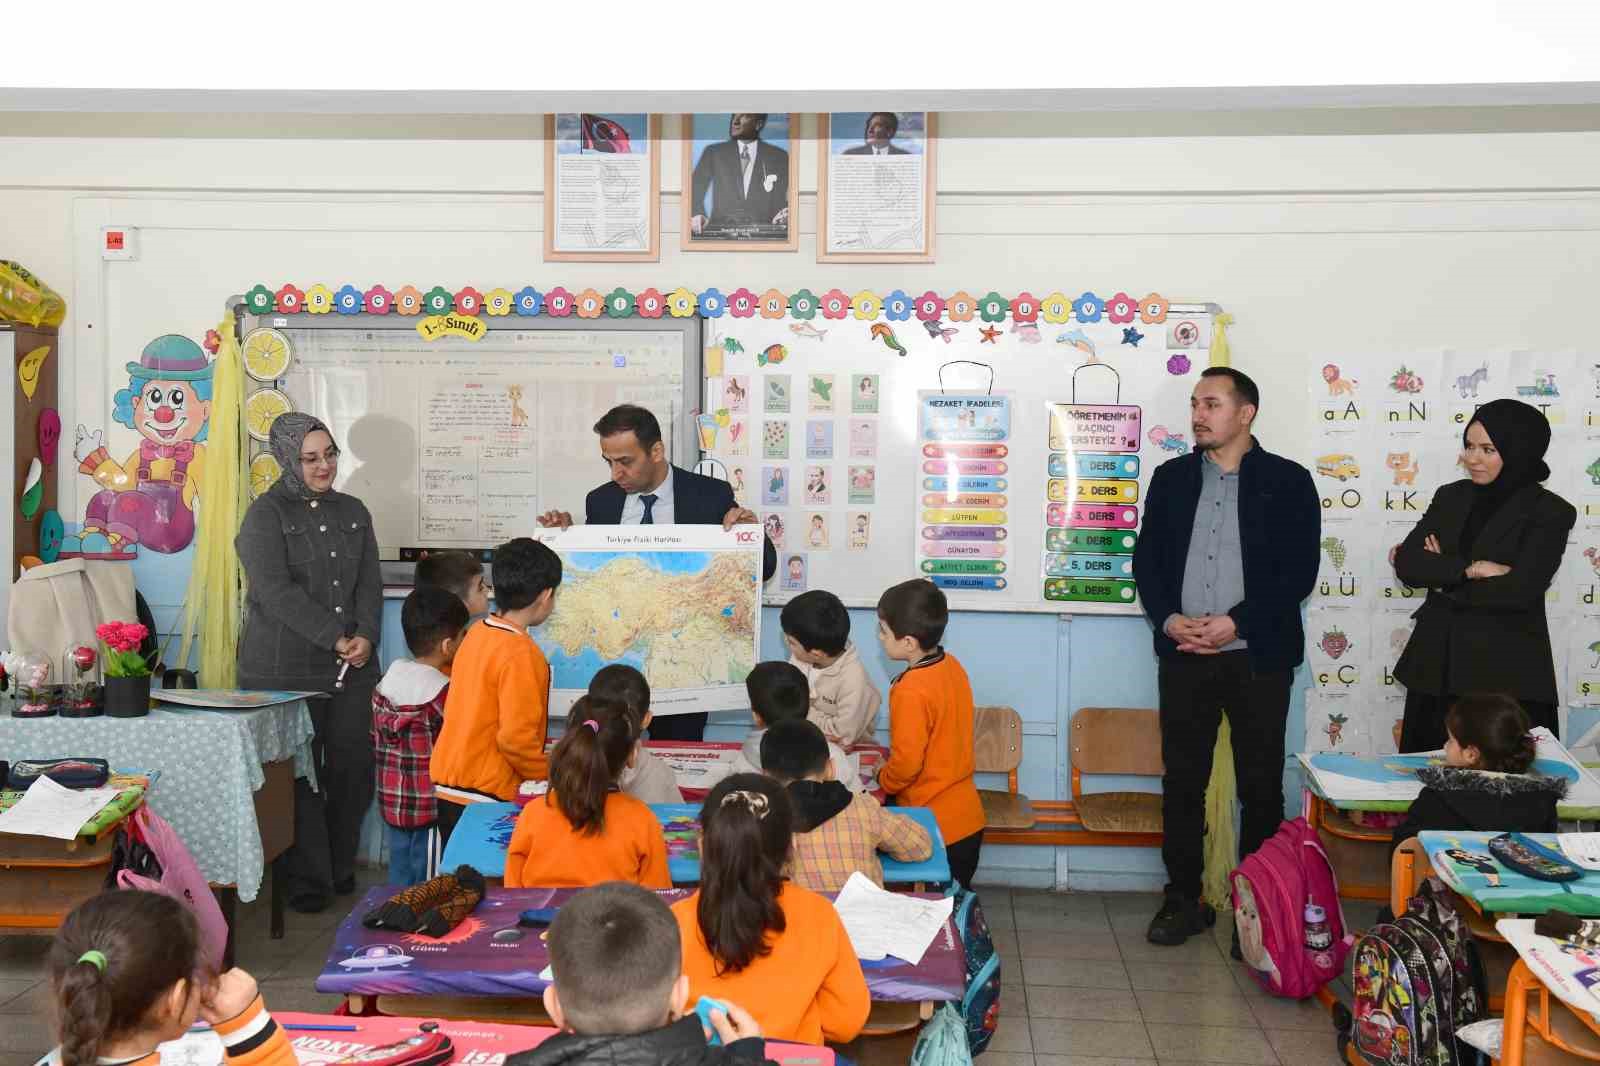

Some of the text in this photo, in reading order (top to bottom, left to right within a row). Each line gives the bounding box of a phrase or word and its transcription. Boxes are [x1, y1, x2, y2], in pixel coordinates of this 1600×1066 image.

[286, 295, 294, 304] A
[405, 297, 413, 305] D
[555, 299, 563, 307] H
[738, 300, 747, 308] M
[769, 301, 777, 310] N
[1084, 304, 1094, 313] V
[1117, 304, 1126, 313] Y
[1151, 305, 1159, 314] Z
[929, 400, 962, 408] NEZAKET
[1066, 435, 1116, 445] ERSTEYİZ
[1090, 461, 1117, 470] DERS
[1091, 486, 1118, 495] DERS
[1089, 511, 1115, 521] DERS
[1087, 536, 1113, 545] DERS
[1071, 560, 1112, 570] 5. DERS
[1085, 586, 1112, 595] DERS
[1583, 585, 1594, 604] d
